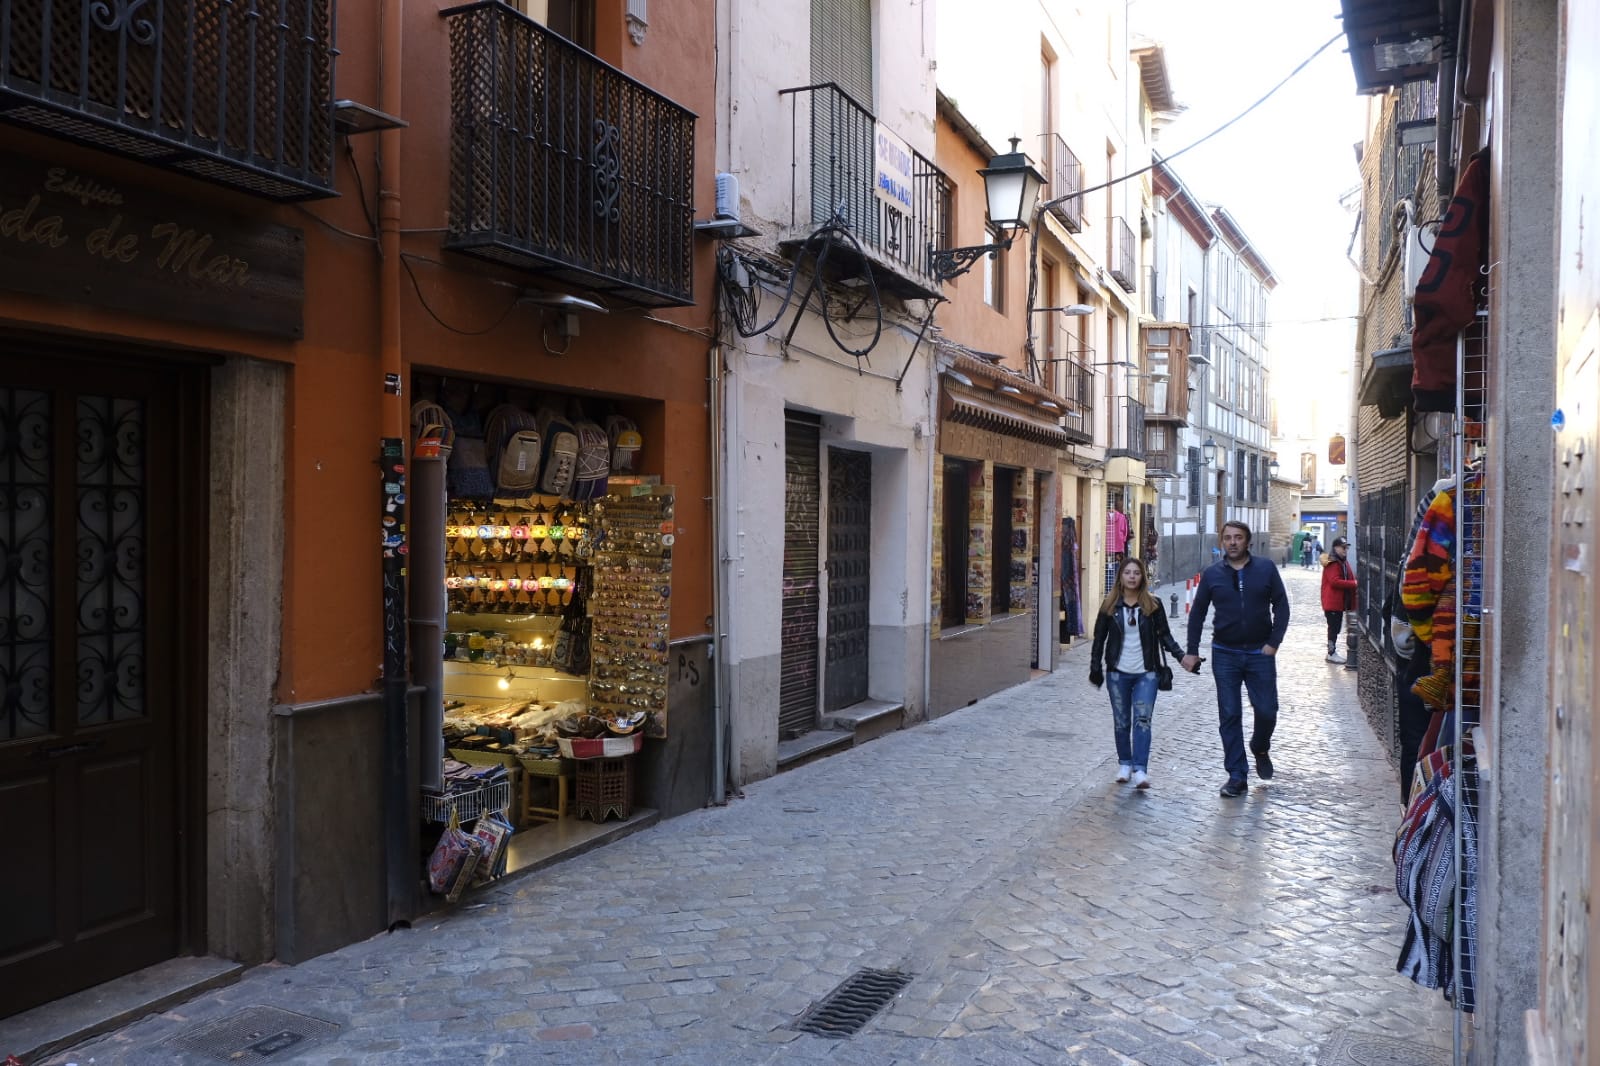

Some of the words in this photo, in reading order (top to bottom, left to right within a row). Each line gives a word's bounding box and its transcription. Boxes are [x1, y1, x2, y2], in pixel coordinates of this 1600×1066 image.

[44, 167, 125, 206] Edificio
[86, 212, 139, 263] de
[152, 222, 251, 287] Mar
